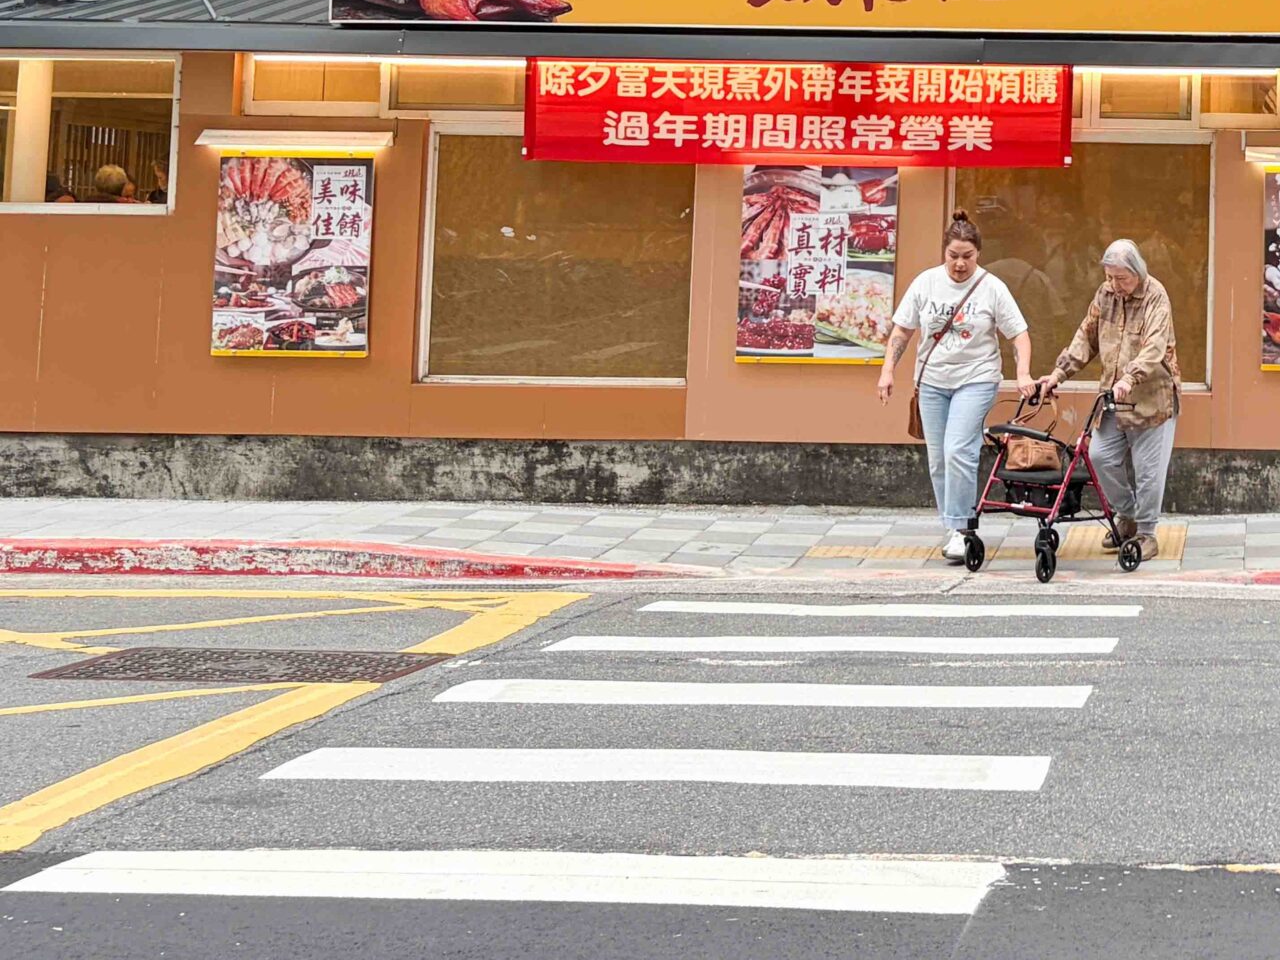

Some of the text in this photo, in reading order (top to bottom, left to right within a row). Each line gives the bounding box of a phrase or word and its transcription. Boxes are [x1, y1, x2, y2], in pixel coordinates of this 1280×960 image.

[539, 63, 1058, 104] 除夕當天現煮外帶年菜開始預購
[602, 110, 994, 152] 過年期間照常營業
[313, 177, 363, 204] 美味
[312, 212, 363, 238] 佳餚
[788, 222, 850, 257] 真材
[789, 262, 845, 298] 實料
[928, 300, 978, 316] Madi
